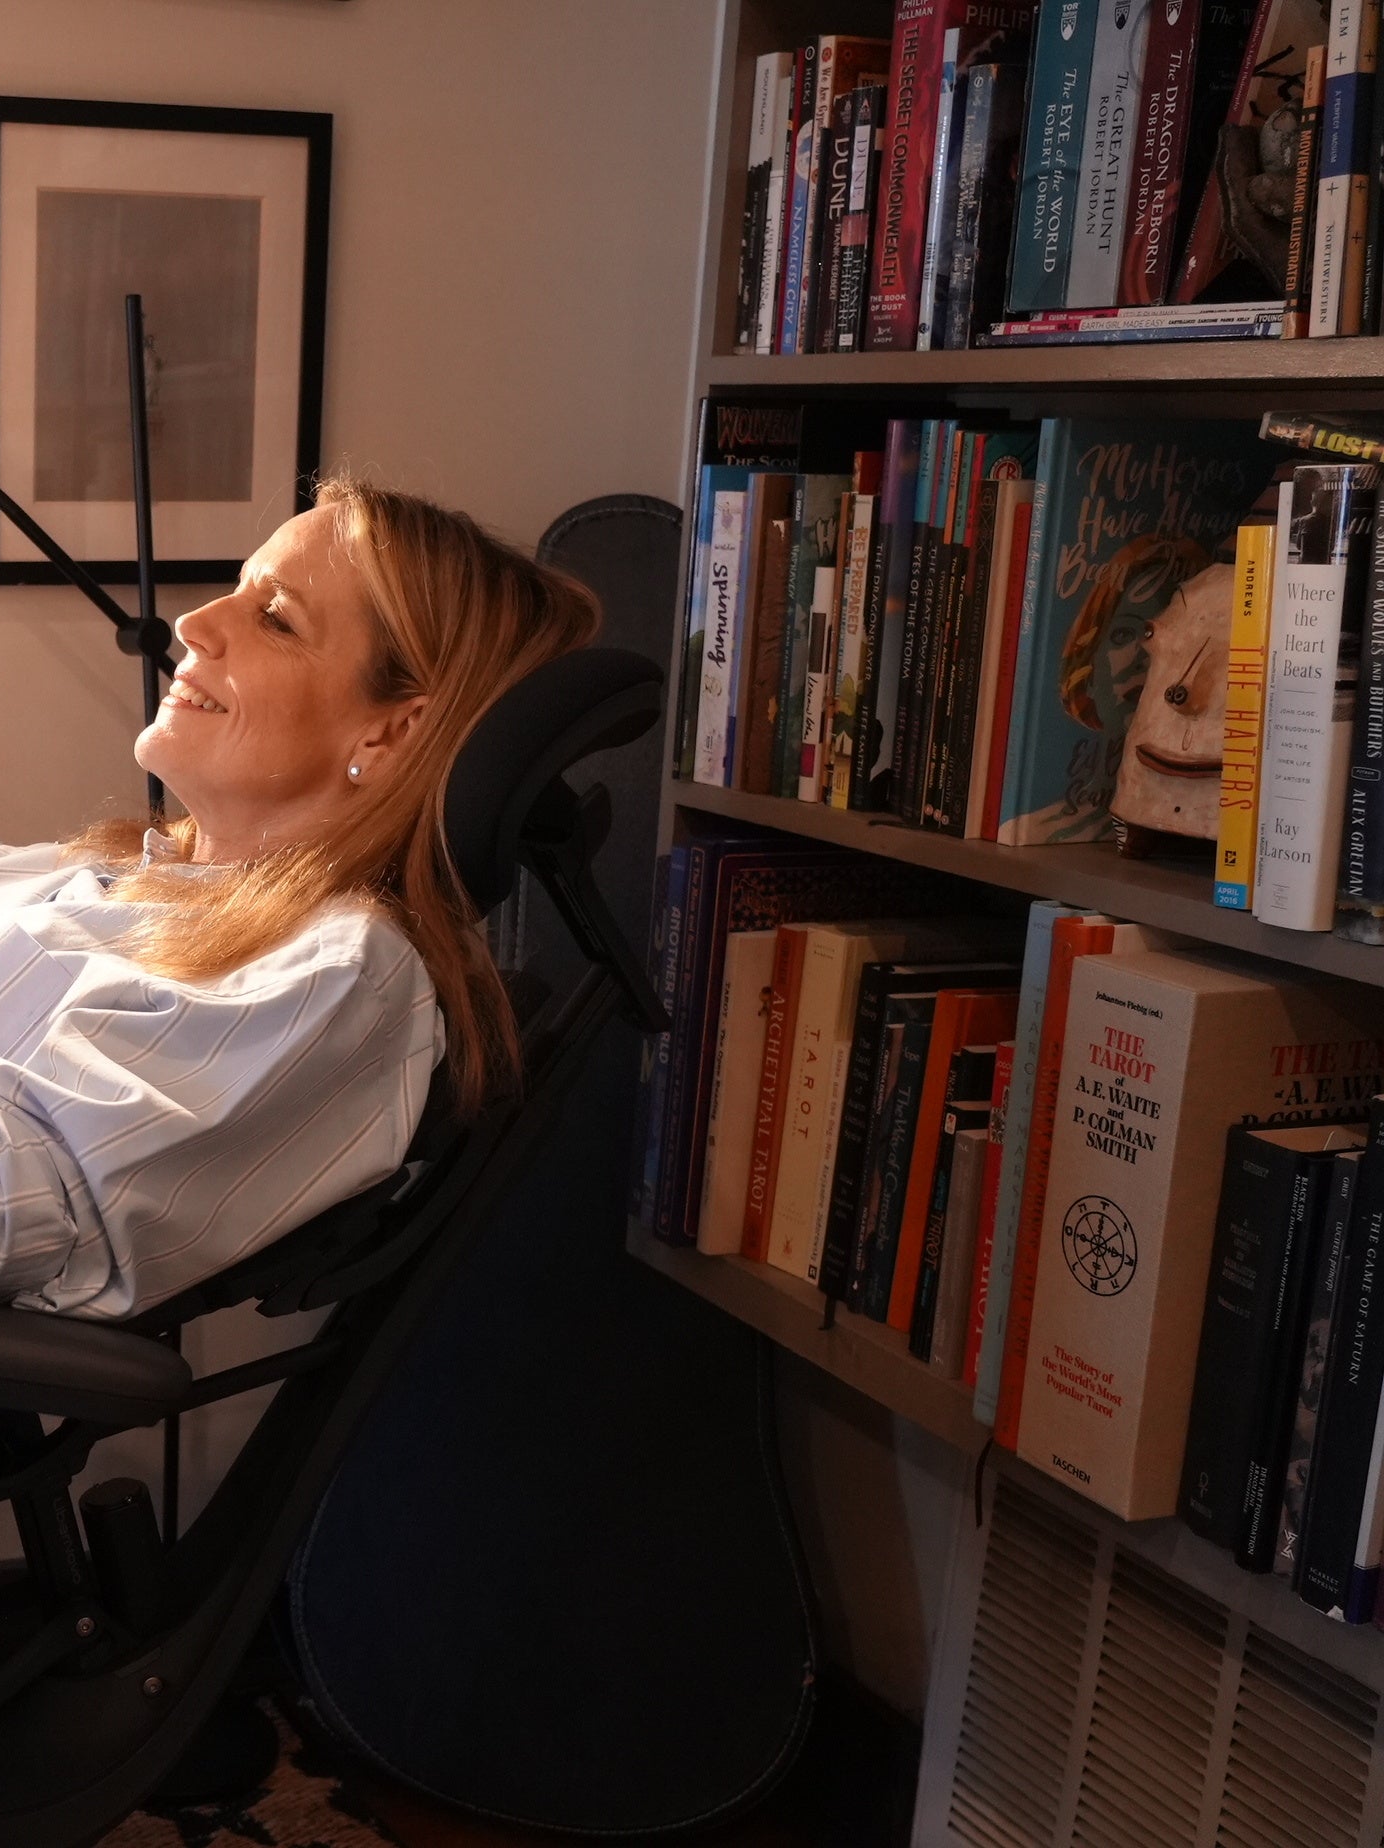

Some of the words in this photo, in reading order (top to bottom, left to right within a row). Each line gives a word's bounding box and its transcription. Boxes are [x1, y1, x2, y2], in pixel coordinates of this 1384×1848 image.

[898, 7, 934, 21] PULLMAN
[967, 5, 1030, 28] PHILIP
[1062, 3, 1079, 12] TOR
[1339, 7, 1351, 37] LEM
[902, 25, 919, 61] THE
[822, 67, 832, 81] We
[1062, 69, 1077, 99] The
[1167, 50, 1183, 81] The
[760, 68, 769, 135] SOUTHLAND
[803, 68, 812, 105] HICKS
[819, 87, 829, 101] Are
[897, 65, 915, 130] SECRET
[1115, 71, 1129, 102] The
[1041, 104, 1056, 168] ROBERT
[1057, 103, 1073, 144] EYE
[1094, 96, 1109, 161] ROBERT
[1107, 107, 1125, 180] GREAT
[1144, 92, 1161, 160] ROBERT
[1155, 86, 1178, 181] DRAGON
[1056, 149, 1066, 167] of
[1293, 130, 1312, 215] MOVIEMAKING
[829, 138, 850, 220] DUNE
[880, 133, 909, 287] COMMONWEALTH
[1033, 176, 1048, 240] JORDAN
[1086, 169, 1101, 235] JORDAN
[1098, 188, 1116, 254] HUNT
[1134, 168, 1152, 235] JORDAN
[788, 206, 802, 285] NAMELESS
[833, 224, 842, 257] FRANK
[1043, 196, 1063, 273] WORLD
[1144, 189, 1166, 275] REBORN
[1285, 217, 1304, 291] ILLUSTRATED
[1320, 225, 1334, 324] NORTHWESTERN
[829, 259, 839, 300] HERBERT
[870, 295, 883, 303] THE
[884, 294, 906, 302] BOOK
[785, 290, 796, 324] CITY
[871, 303, 880, 311] OF
[882, 303, 903, 311] DUST
[1081, 322, 1104, 331] EARTH
[1106, 321, 1121, 329] GIRL
[1123, 320, 1143, 328] MADE
[1314, 429, 1378, 460] LOST
[1076, 443, 1149, 502] My
[1150, 444, 1245, 497] Heroes
[795, 504, 803, 521] ROAR
[1078, 496, 1149, 557] Have
[855, 527, 868, 551] BE
[874, 543, 883, 573] THE
[912, 545, 923, 575] EYES
[929, 546, 937, 574] THE
[1057, 537, 1132, 600] Been
[847, 557, 866, 635] PREPARED
[910, 579, 919, 597] OF
[925, 578, 934, 622] GREAT
[946, 576, 955, 619] Complete
[1243, 560, 1255, 617] ANDREWS
[1287, 583, 1335, 602] Where
[707, 563, 730, 669] Spinning
[864, 578, 881, 681] DRAGONSLAYER
[907, 602, 917, 627] THE
[955, 593, 964, 637] Complete
[1294, 609, 1318, 627] the
[1371, 599, 1384, 657] WOLVES
[902, 631, 913, 680] STORM
[920, 626, 928, 660] COW
[1285, 634, 1325, 654] Heart
[916, 662, 925, 697] RACE
[938, 646, 947, 698] Adventures
[1227, 645, 1264, 692] THE
[1283, 660, 1322, 679] Beats
[1372, 662, 1381, 681] AND
[947, 664, 956, 716] Adventures
[860, 705, 868, 732] JEFF
[899, 706, 907, 731] JEFF
[1367, 687, 1384, 758] BUTCHERS
[856, 736, 865, 778] SMITH
[894, 735, 903, 778] SMITH
[1218, 709, 1259, 810] HATERS
[1296, 760, 1311, 768] LIFE
[1352, 788, 1366, 826] ALEX
[1275, 818, 1300, 841] Kay
[1264, 842, 1311, 864] Larson
[1349, 833, 1364, 896] GRECIAN
[1217, 887, 1239, 896] APRIL
[665, 905, 681, 993] ANOTHER
[721, 981, 731, 1018] TAROT
[1148, 1007, 1163, 1020] (ed.)
[1104, 1026, 1145, 1058] THE
[1271, 1042, 1338, 1077] THE
[757, 990, 786, 1137] ARCHETYPAL
[798, 1028, 822, 1140] TAROT
[1089, 1043, 1156, 1085] TAROT
[1115, 1077, 1125, 1087] of
[711, 1079, 721, 1120] Reading
[1075, 1076, 1090, 1094] A.
[1092, 1081, 1105, 1100] E.
[1109, 1086, 1161, 1120] WAITE
[1107, 1107, 1124, 1121] and
[1073, 1106, 1085, 1125] P.
[1088, 1112, 1157, 1152] COLMAN
[1086, 1130, 1138, 1166] SMITH
[750, 1149, 769, 1214] TAROT
[1299, 1176, 1309, 1203] BLACK
[1341, 1176, 1350, 1200] GREY
[876, 1172, 898, 1252] Cartouche
[1297, 1205, 1305, 1222] SUN
[1368, 1212, 1383, 1244] THE
[925, 1213, 943, 1270] TAROT
[1362, 1248, 1377, 1293] GAME
[1360, 1297, 1370, 1318] OF
[1055, 1345, 1073, 1364] The
[1075, 1355, 1101, 1380] Story
[1102, 1372, 1114, 1385] of
[1348, 1321, 1367, 1385] SATURN
[1042, 1356, 1057, 1372] the
[1059, 1366, 1095, 1392] World's
[1097, 1385, 1122, 1407] Most
[1046, 1374, 1084, 1403] Popular
[1086, 1395, 1113, 1419] Tarot
[1052, 1454, 1091, 1485] TASCHEN
[1248, 1503, 1262, 1556] FOUNDATION
[1308, 1575, 1339, 1594] IMPRINT
[1310, 1567, 1339, 1586] SCARLET
